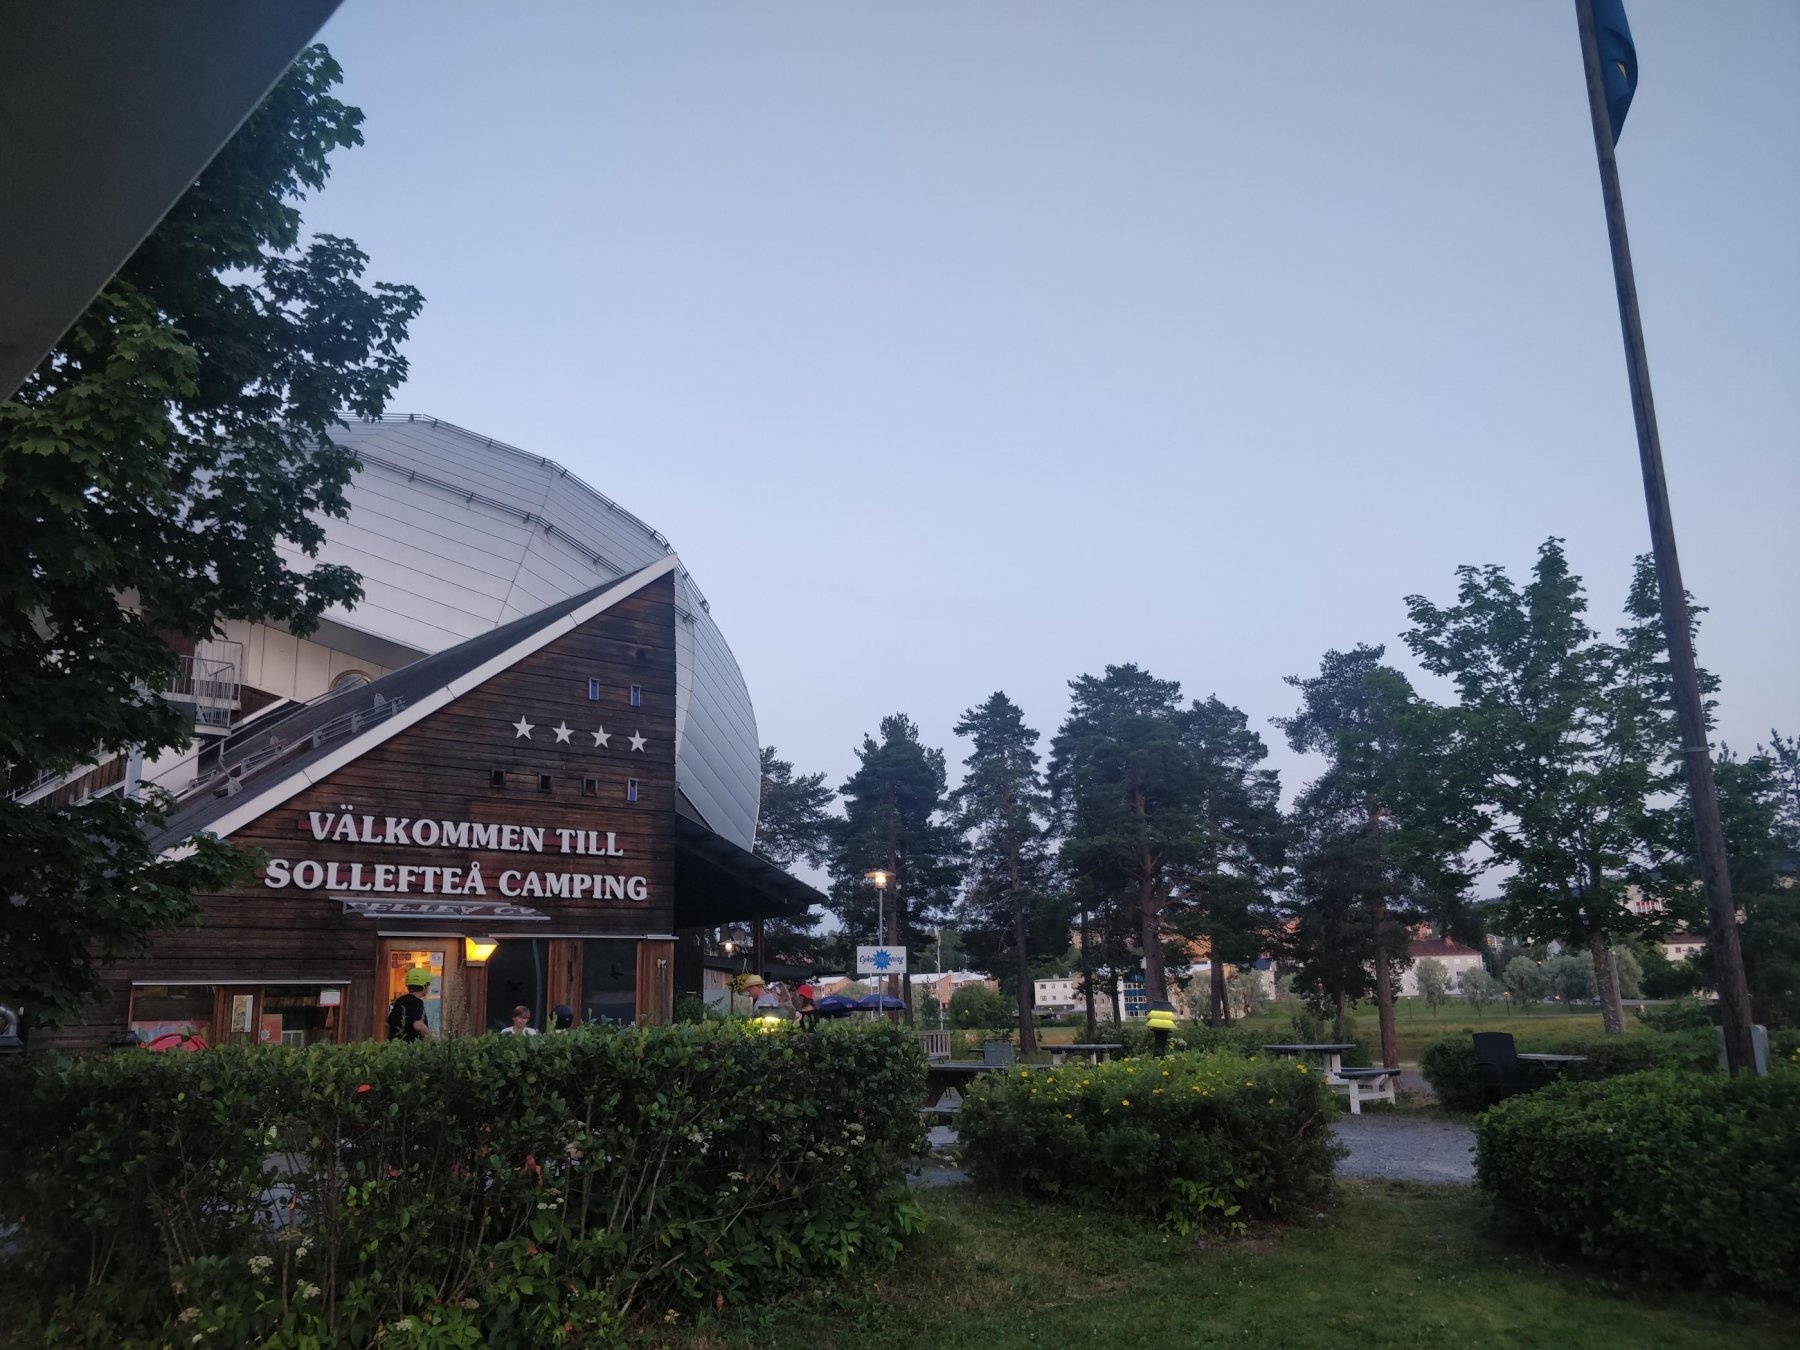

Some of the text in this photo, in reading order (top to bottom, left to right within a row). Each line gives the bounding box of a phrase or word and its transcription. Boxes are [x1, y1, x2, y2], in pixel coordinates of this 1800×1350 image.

[308, 804, 623, 856] VÄLKOMMEN TILL
[264, 859, 648, 901] SOLLEFTEÅ CAMPING
